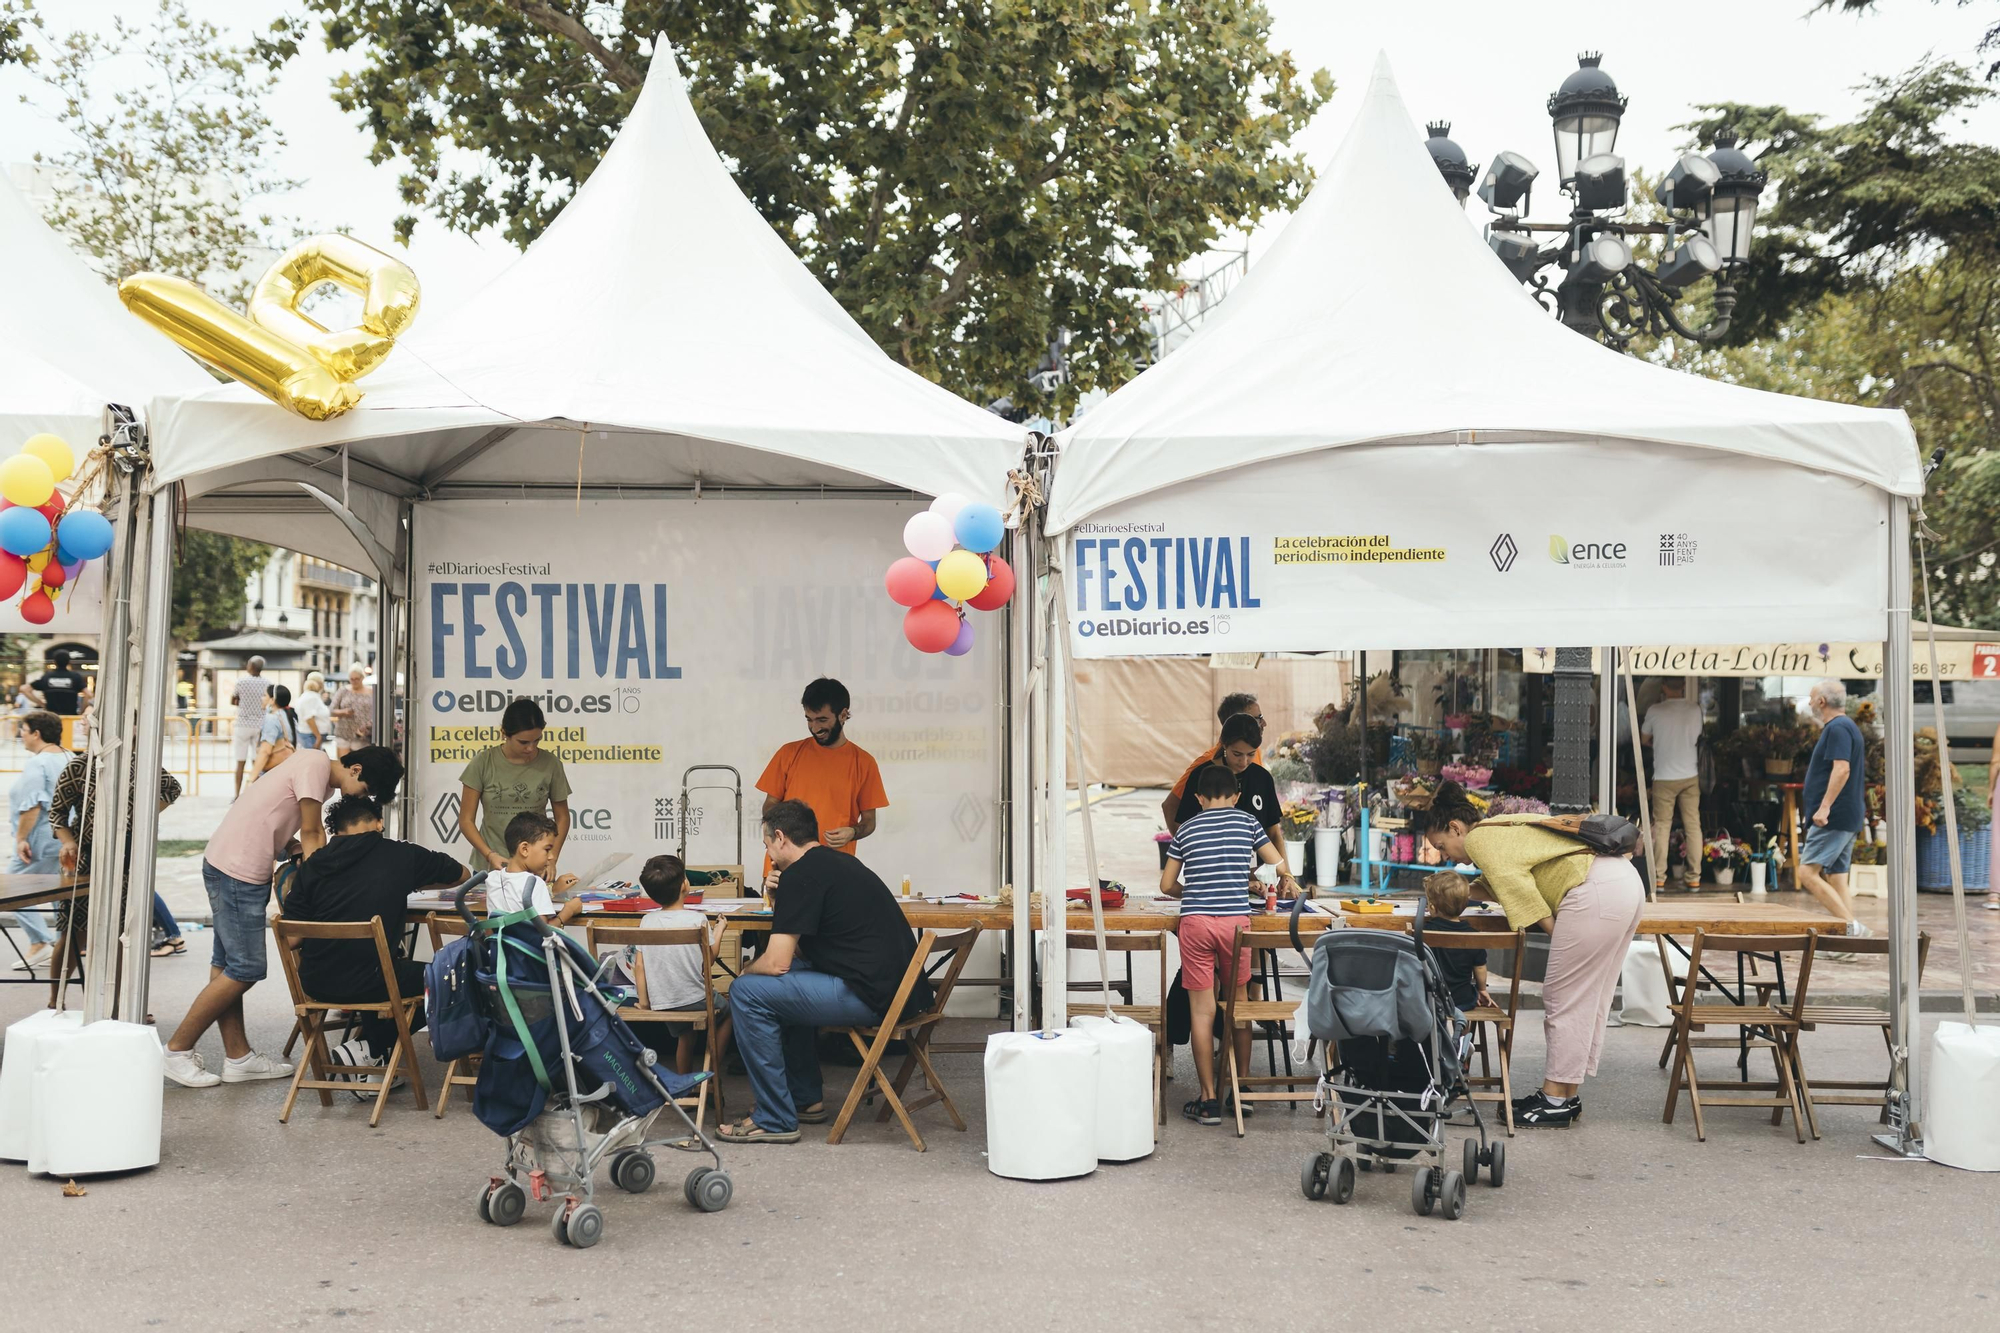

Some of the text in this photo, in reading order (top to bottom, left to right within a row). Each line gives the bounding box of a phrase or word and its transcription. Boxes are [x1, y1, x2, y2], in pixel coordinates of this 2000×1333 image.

[1073, 523, 1165, 533] #elDiarioesFestival
[1274, 535, 1389, 549] La celebración del
[1572, 542, 1627, 560] ence
[1274, 548, 1445, 565] periodismo independiente
[428, 562, 551, 575] #elDiarioesFestival
[1076, 537, 1261, 611] FESTIVAL
[430, 581, 682, 680] FESTIVAL
[1096, 614, 1231, 636] elDiario.es 10
[1983, 656, 1997, 676] 2
[457, 687, 641, 714] elDirio.es 10
[430, 726, 585, 742] La celebn del
[550, 745, 661, 763] dependiente
[603, 1050, 638, 1094] MACLAREN
